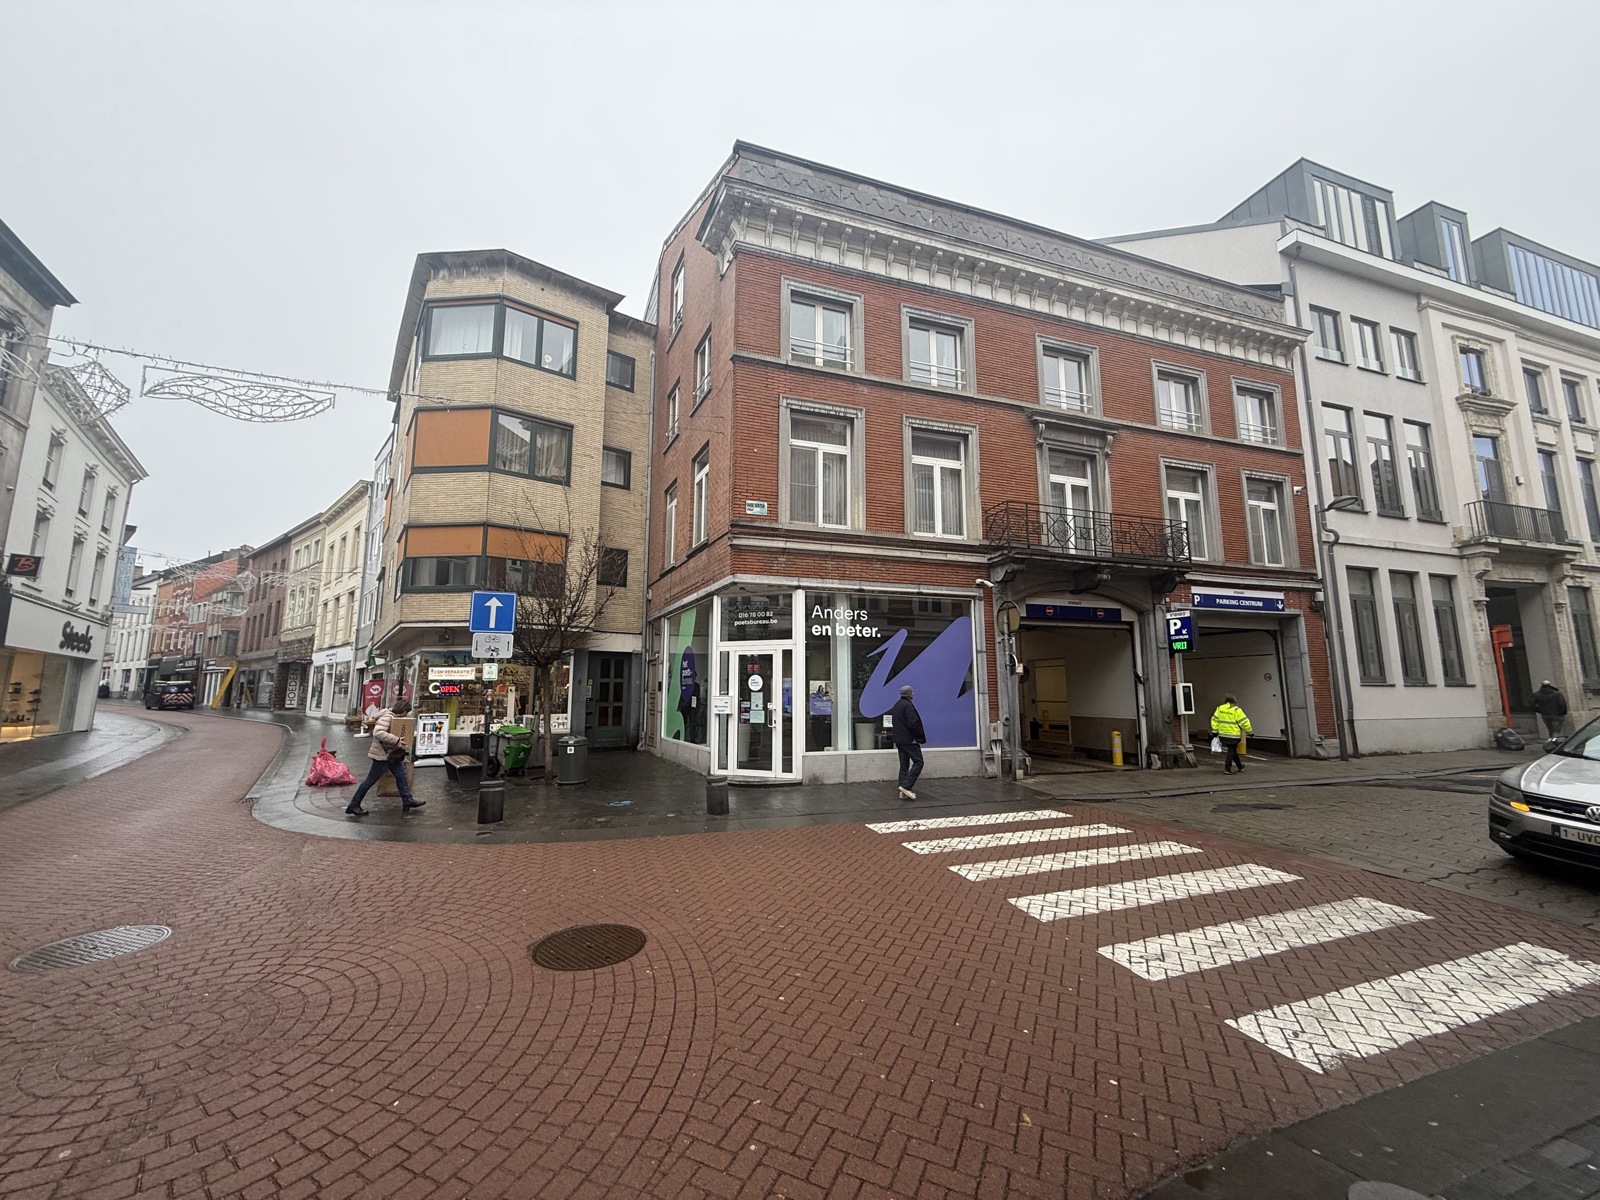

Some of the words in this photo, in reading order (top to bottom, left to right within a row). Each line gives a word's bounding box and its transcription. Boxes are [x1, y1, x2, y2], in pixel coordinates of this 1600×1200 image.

[1194, 595, 1200, 605] P
[812, 605, 868, 620] Anders
[812, 626, 832, 636] en
[836, 623, 881, 638] beter.
[1169, 619, 1181, 635] P
[286, 668, 298, 706] HOEDEN
